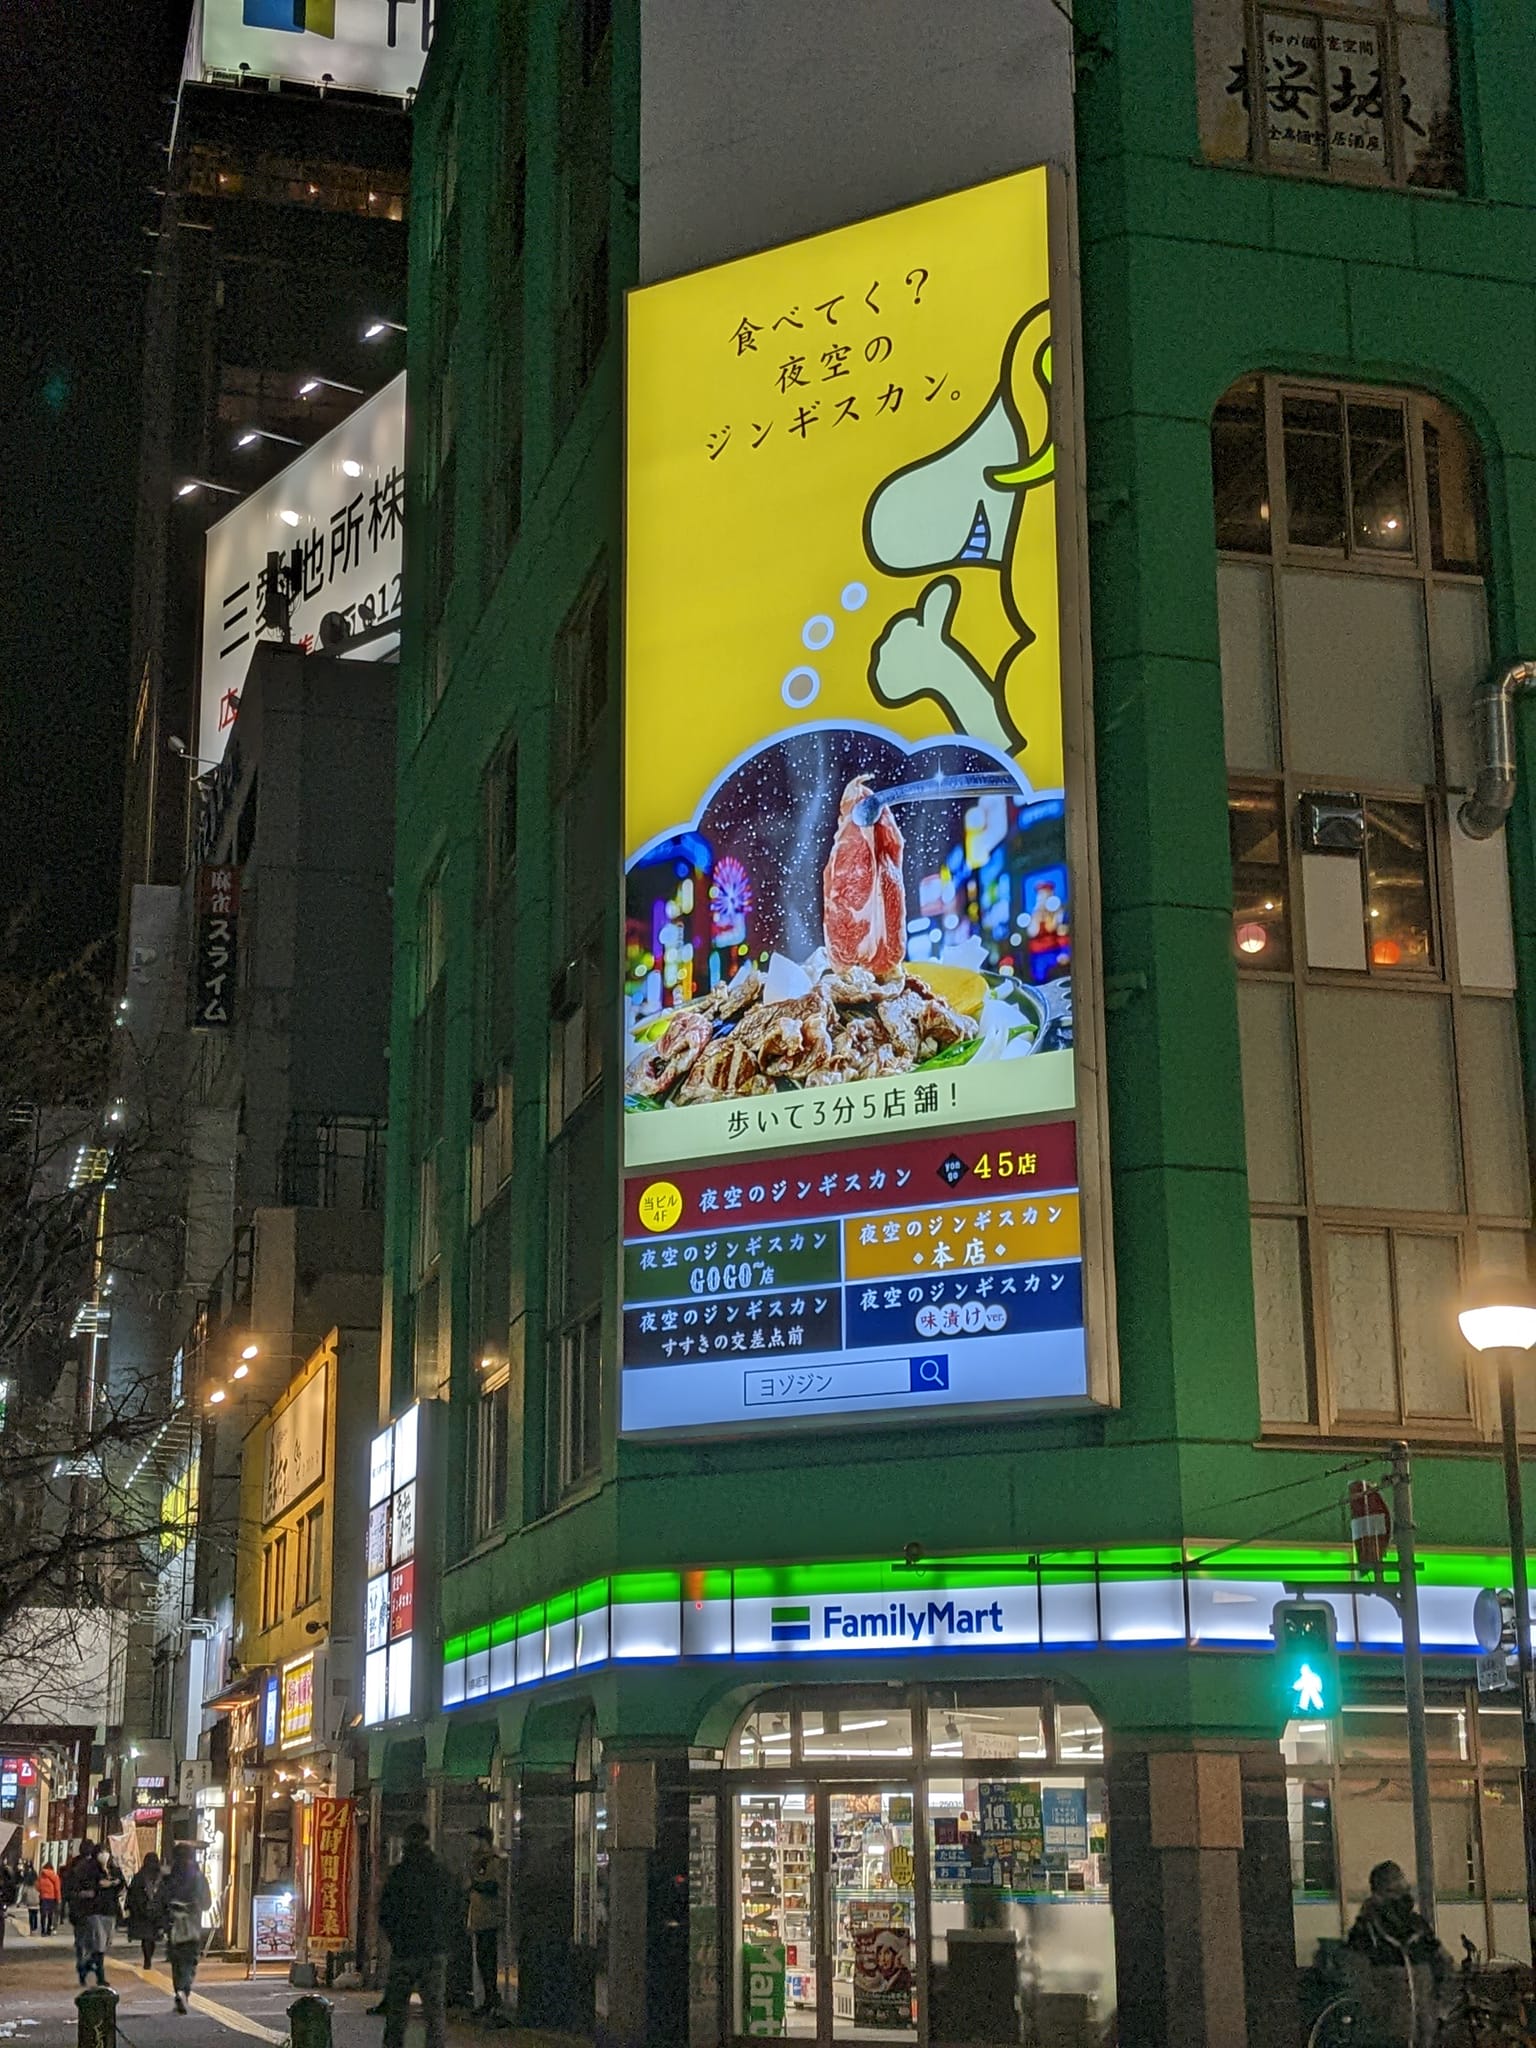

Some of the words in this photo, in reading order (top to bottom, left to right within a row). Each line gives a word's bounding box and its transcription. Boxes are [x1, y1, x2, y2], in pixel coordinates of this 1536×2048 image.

[729, 268, 929, 356] 食べてく？
[774, 335, 893, 394] 夜空の
[705, 372, 961, 461] ジンギスカン。
[727, 1082, 958, 1139] 歩いて3分5店舗！
[944, 1161, 961, 1172] yon
[947, 1172, 959, 1183] go
[973, 1151, 1037, 1180] 45店
[644, 1194, 678, 1211] 当ビル
[699, 1167, 912, 1213] 夜空のジンギスカン
[653, 1210, 668, 1222] 4F
[859, 1205, 1063, 1246] 夜空のジンギスカン
[640, 1232, 827, 1271] 夜空のジンギスカン
[931, 1237, 987, 1269] 本店
[860, 1272, 1065, 1311] 夜空のジンギスカン
[639, 1296, 828, 1334] 夜空のジンギスカン
[661, 1327, 805, 1357] すすきの交差点前
[760, 1373, 833, 1397] ヨゾジン
[824, 1601, 1003, 1640] FamilyMart
[320, 1801, 350, 1936] 24時間営業
